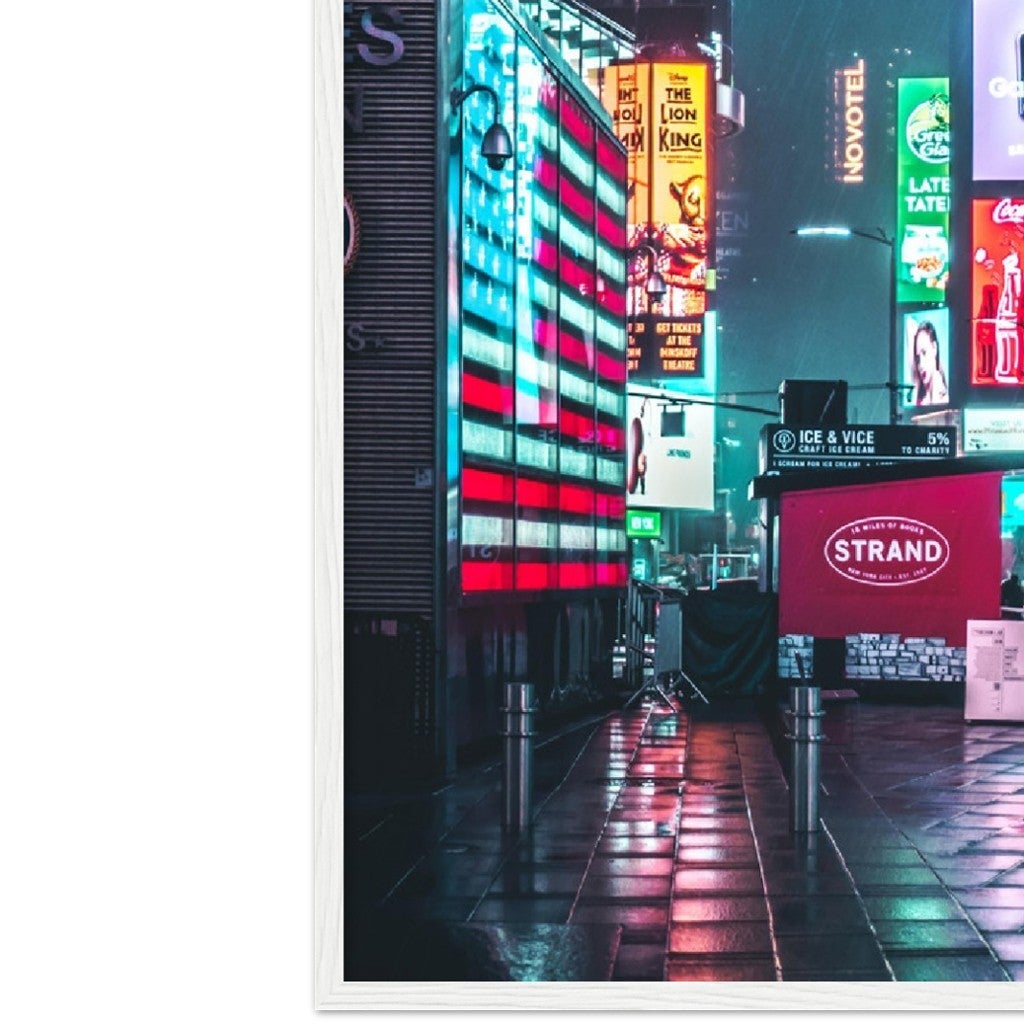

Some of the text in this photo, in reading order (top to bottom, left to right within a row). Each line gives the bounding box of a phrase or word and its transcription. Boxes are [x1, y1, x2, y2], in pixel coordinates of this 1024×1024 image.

[665, 87, 691, 100] THE
[661, 103, 697, 124] LION
[844, 59, 864, 183] NOVOTEL
[659, 127, 702, 152] KING
[905, 196, 950, 212] TATE
[656, 323, 670, 333] GET
[666, 335, 691, 345] AT THE
[800, 430, 874, 444] ICE & VICE
[928, 433, 949, 445] 5%
[834, 538, 942, 562] STRAND
